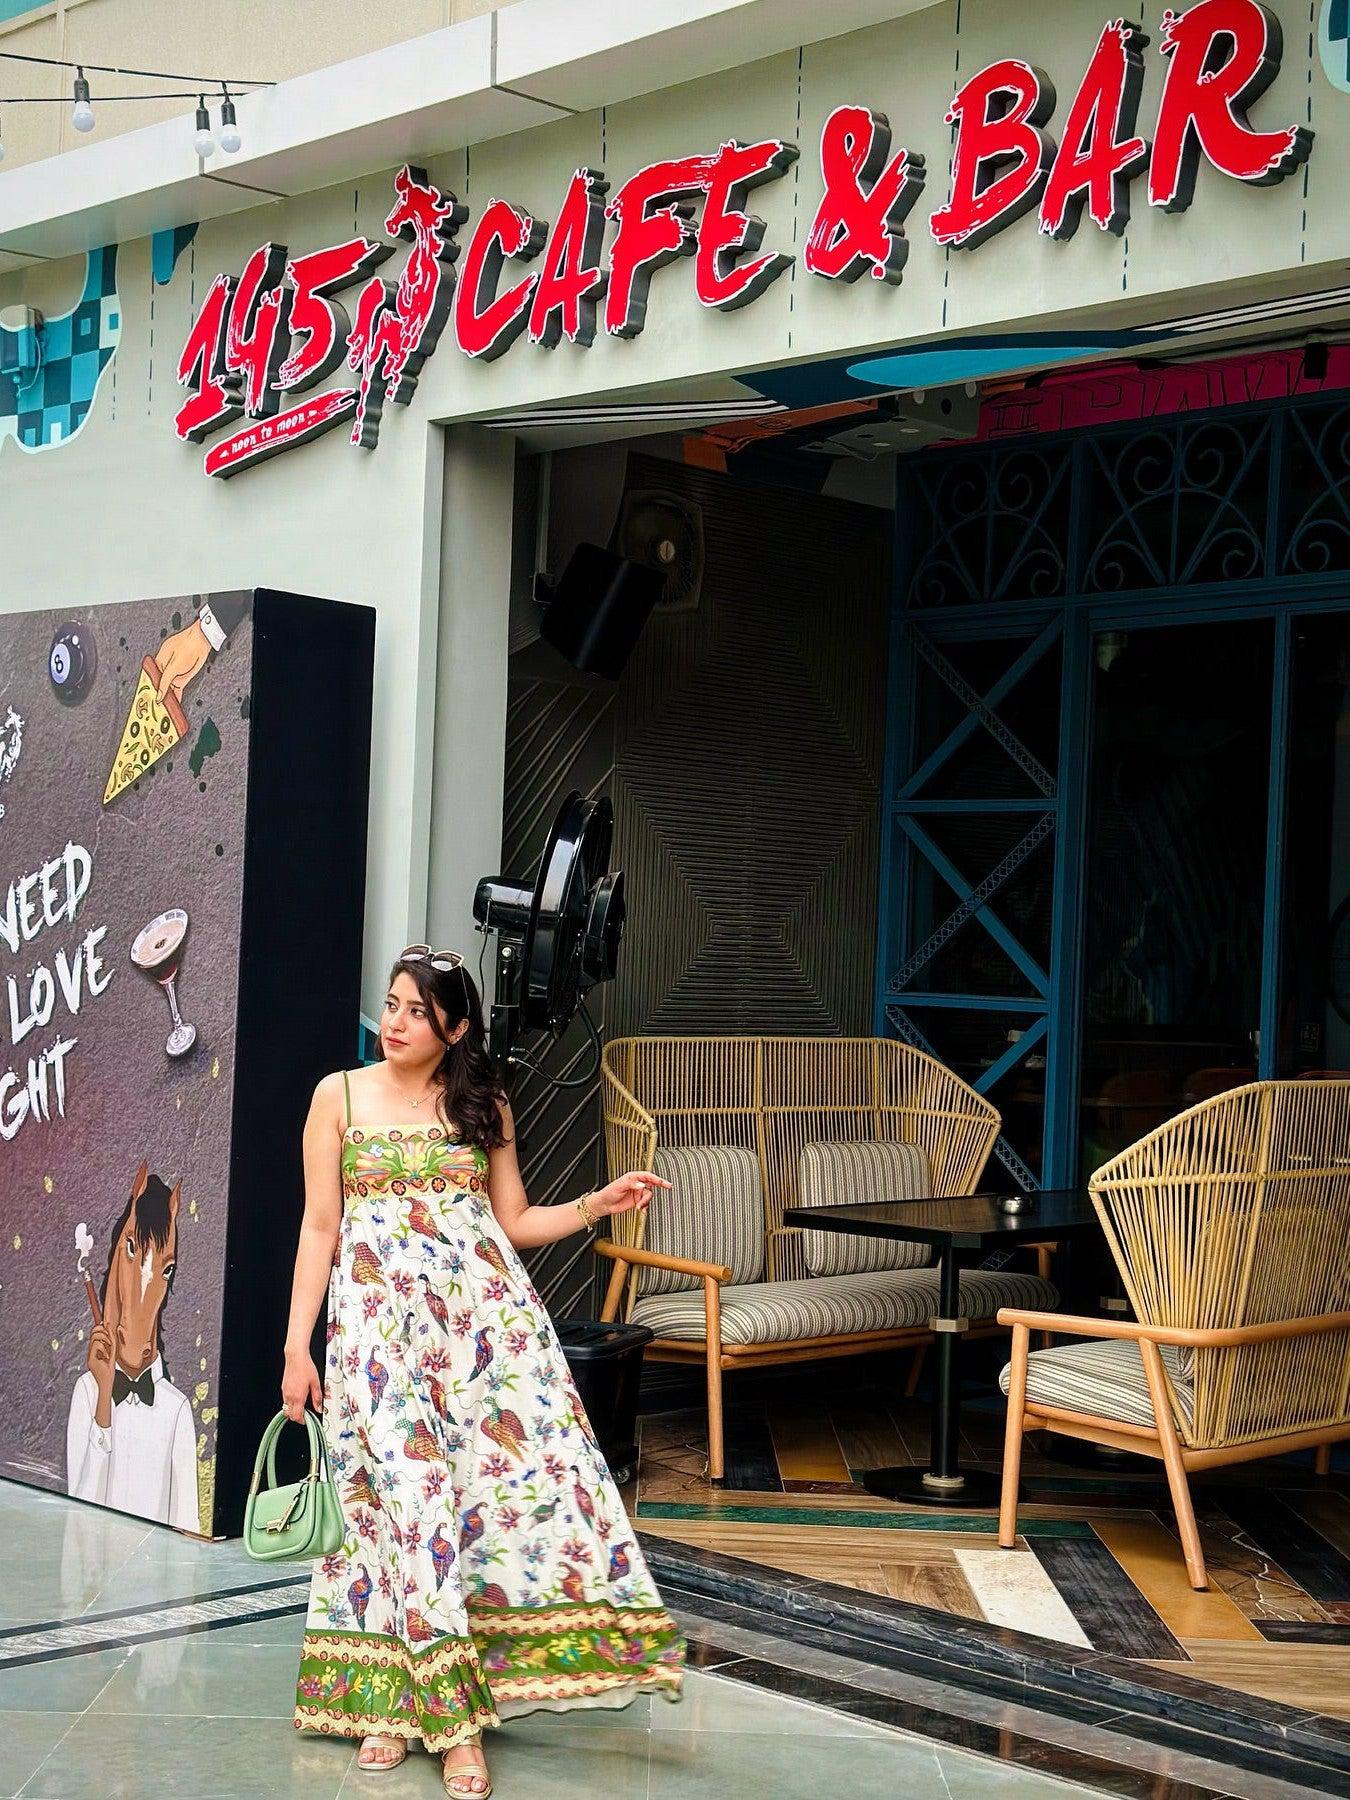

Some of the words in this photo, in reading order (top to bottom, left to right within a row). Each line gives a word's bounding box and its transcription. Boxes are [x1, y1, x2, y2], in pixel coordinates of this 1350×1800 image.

[174, 237, 380, 442] 145
[455, 139, 795, 360] CAFE
[806, 105, 910, 281] &
[930, 0, 1303, 245] BAR
[261, 425, 273, 440] to
[6, 924, 115, 1044] LOVE
